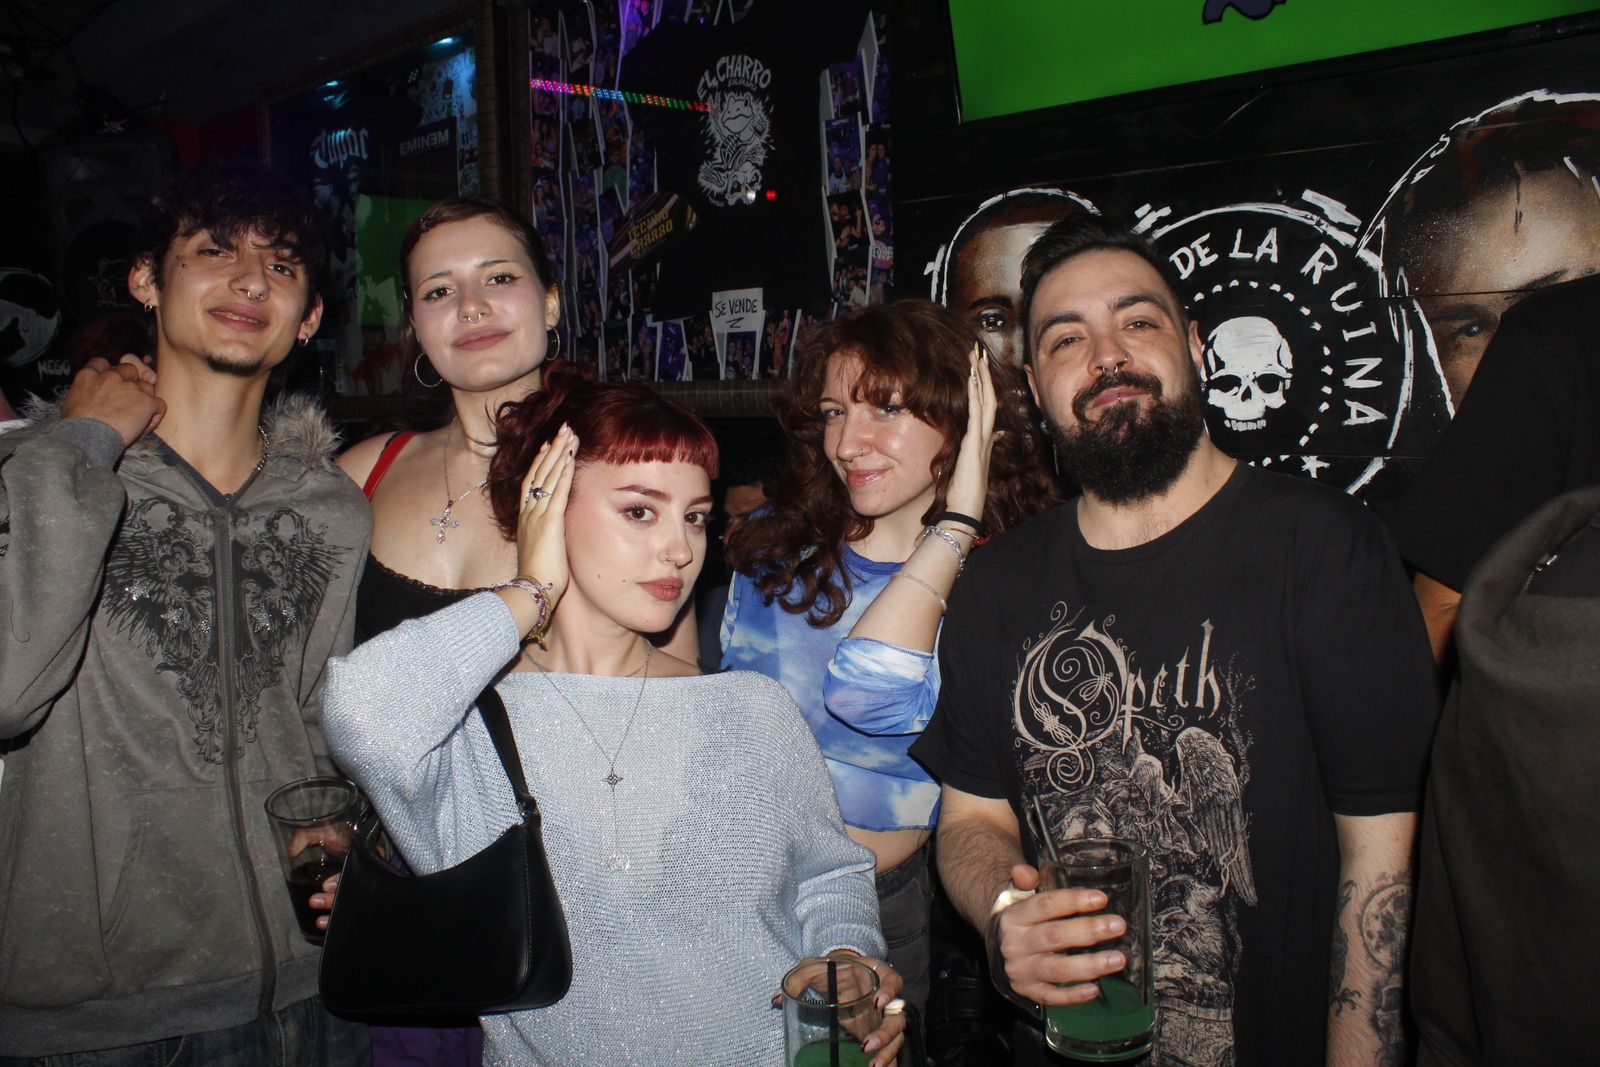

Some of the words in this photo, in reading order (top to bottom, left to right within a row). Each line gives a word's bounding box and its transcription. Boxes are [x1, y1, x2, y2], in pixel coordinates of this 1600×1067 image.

[697, 69, 719, 100] EL
[716, 54, 772, 89] CHARRO
[630, 218, 674, 257] CHARRO
[714, 300, 727, 318] SE
[728, 298, 758, 316] VENDE
[1169, 232, 1219, 280] DE
[1229, 227, 1279, 264] LA
[1300, 242, 1388, 427] RUINA
[1010, 602, 1222, 790] Opeth
